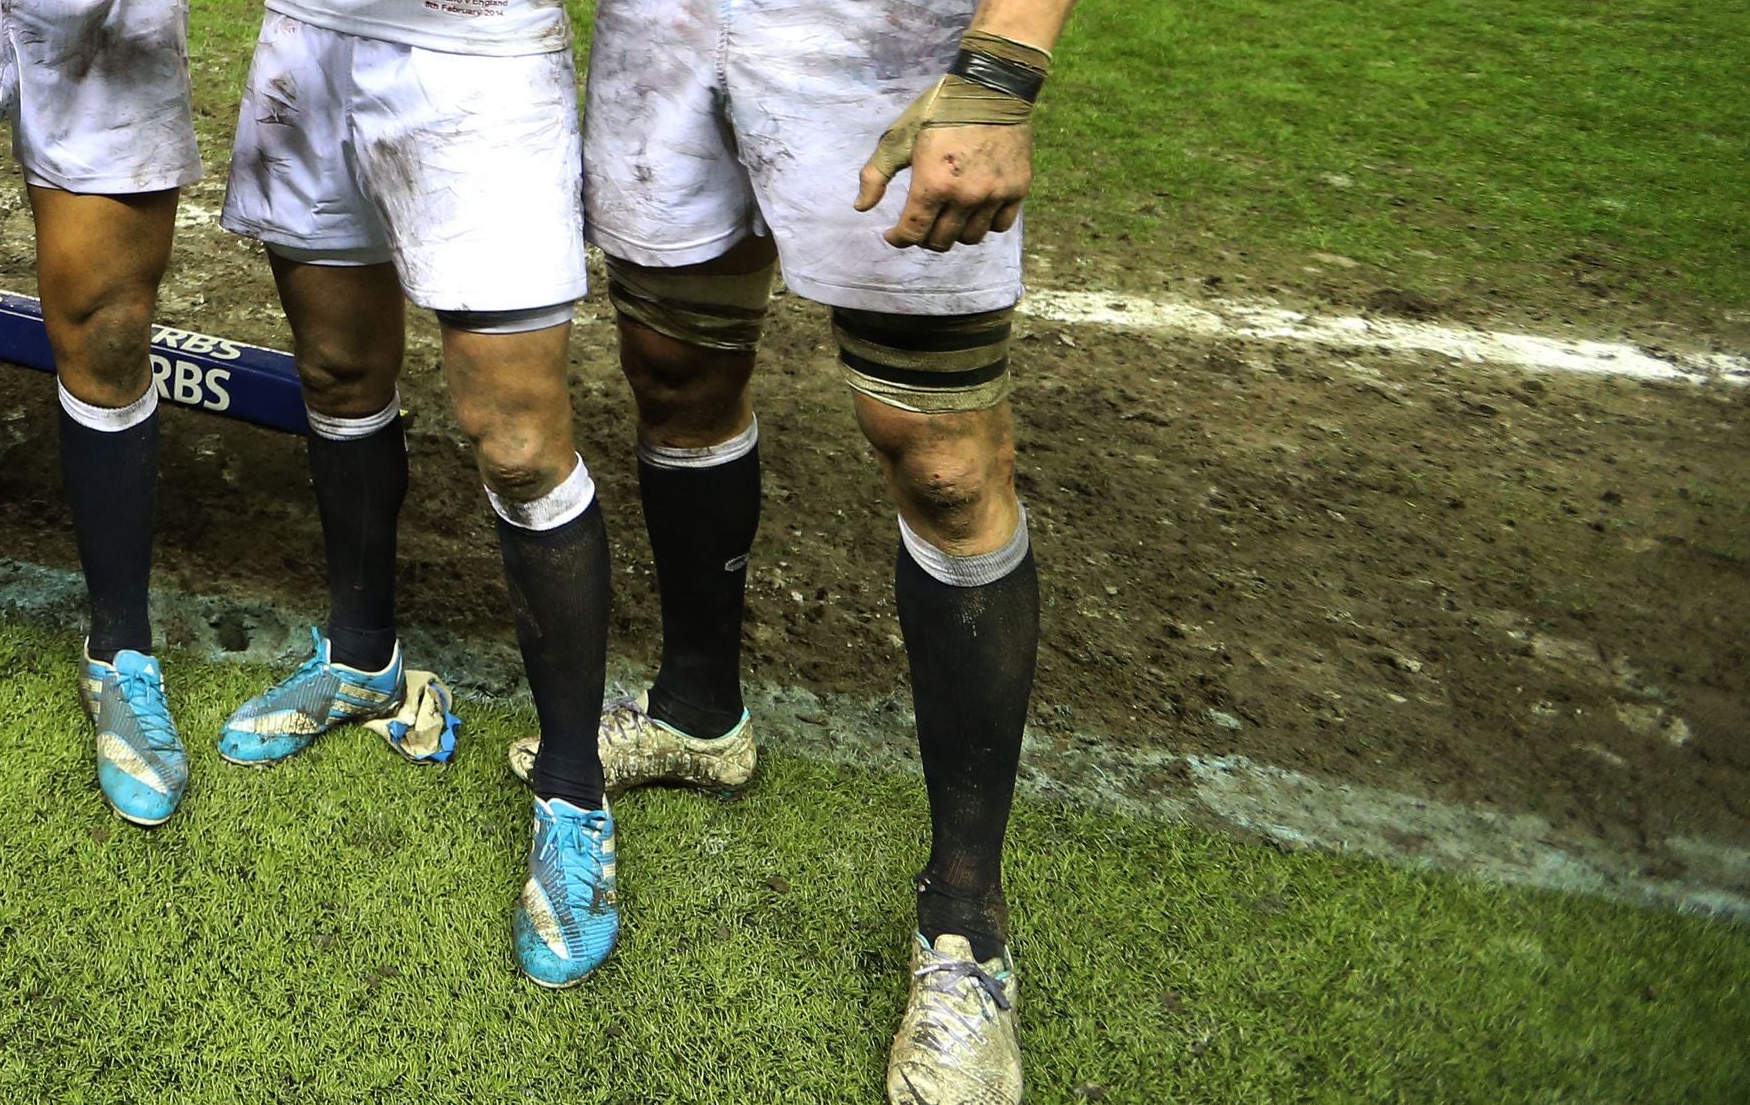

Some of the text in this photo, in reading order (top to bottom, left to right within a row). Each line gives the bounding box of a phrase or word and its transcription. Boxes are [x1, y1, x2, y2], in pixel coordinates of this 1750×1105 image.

[441, 4, 483, 16] February
[151, 326, 242, 360] RBS
[151, 355, 232, 412] RBS
